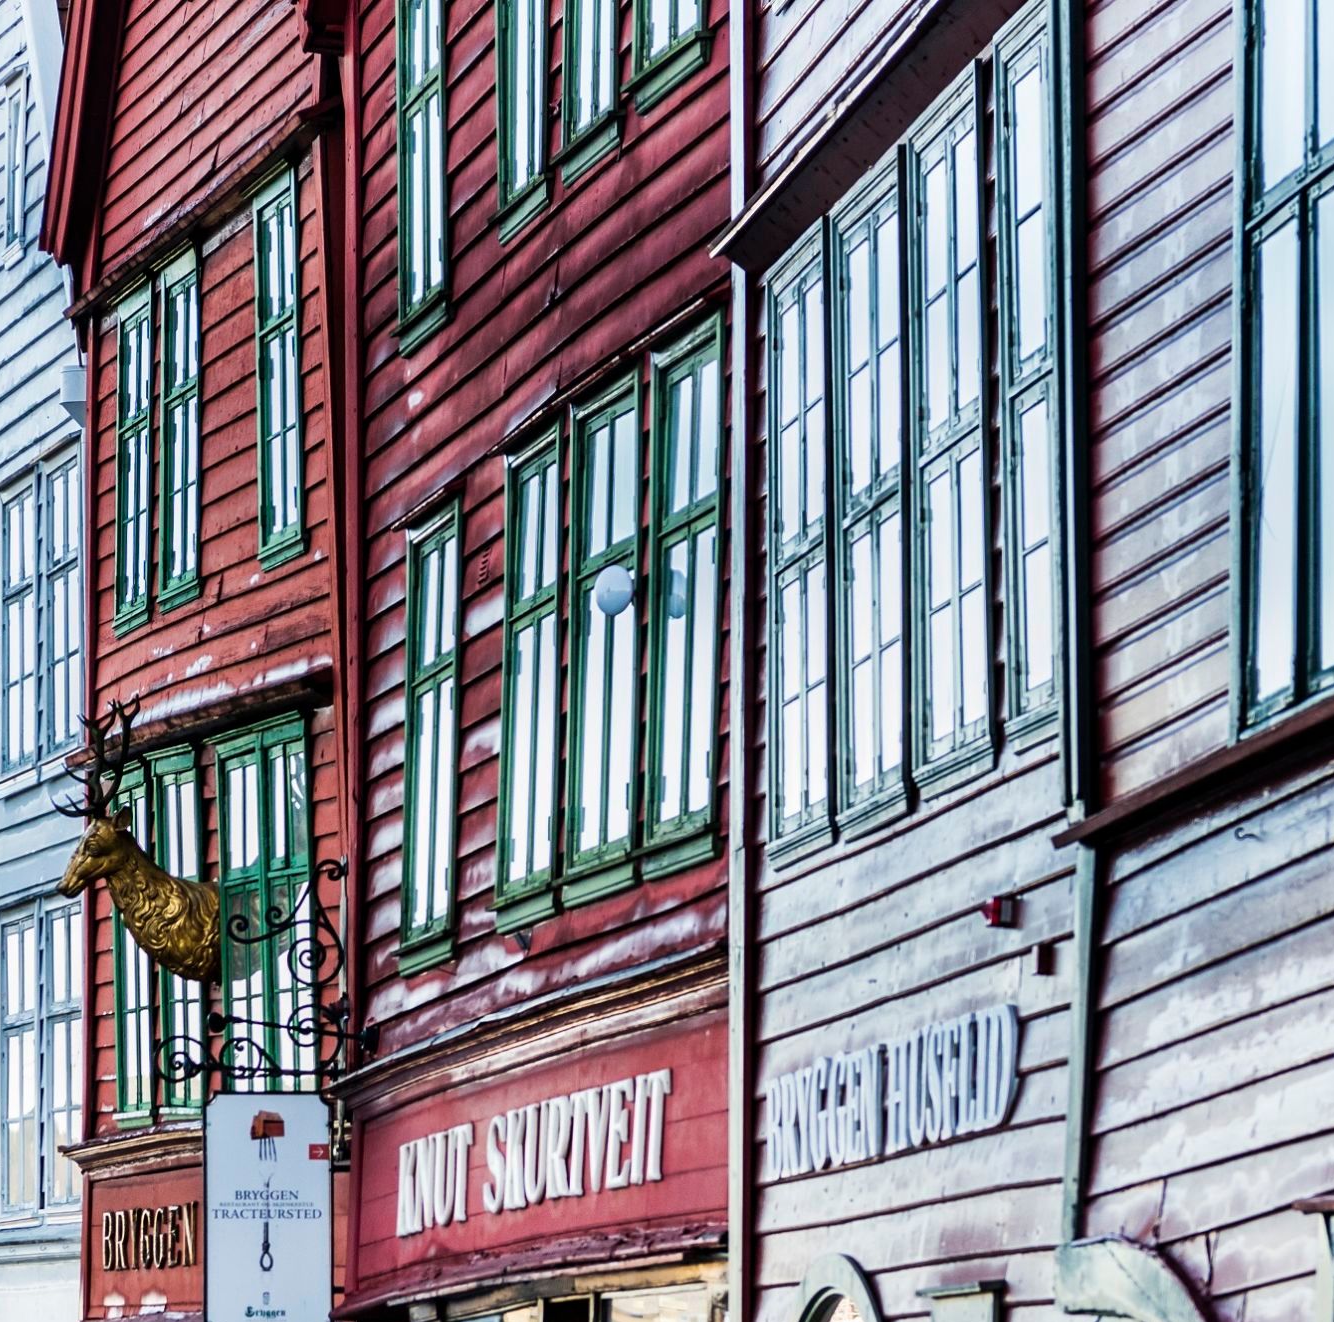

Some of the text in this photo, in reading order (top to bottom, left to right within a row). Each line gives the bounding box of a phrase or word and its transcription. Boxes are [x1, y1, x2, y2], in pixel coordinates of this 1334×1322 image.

[765, 1004, 1018, 1181] BRYGGEN HUSFLID
[396, 1068, 672, 1237] KNUT SKURTVEIT
[212, 1209, 322, 1219] TRACTEURSTED
[235, 1190, 299, 1200] BRYGGEN
[102, 1201, 198, 1271] BRYGGEN
